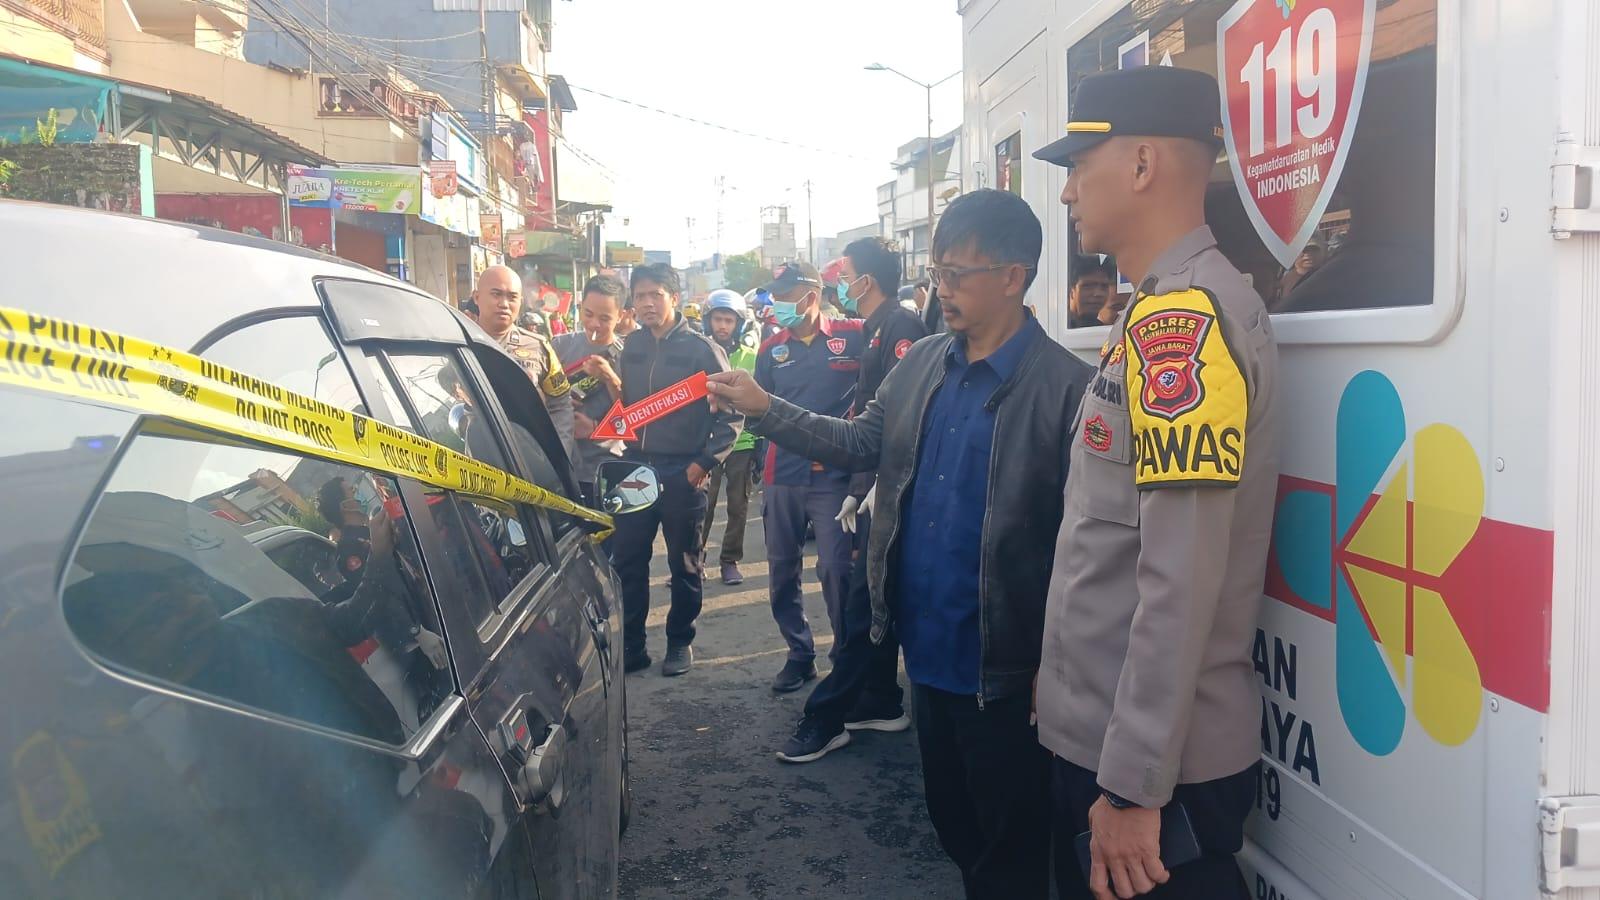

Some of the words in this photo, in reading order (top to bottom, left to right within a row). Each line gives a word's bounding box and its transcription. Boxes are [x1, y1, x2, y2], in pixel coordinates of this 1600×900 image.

[1240, 7, 1337, 158] 119
[1247, 147, 1310, 180] Kegawatdaruratan
[1311, 138, 1335, 158] Medik
[1257, 164, 1320, 199] INDONESIA
[1138, 317, 1197, 337] POLRES
[1148, 344, 1166, 355] JAWA
[1167, 342, 1192, 352] BARAT
[626, 387, 689, 425] IDENTIFIKASI
[235, 397, 257, 422] DO
[263, 405, 289, 432] NOT
[293, 415, 338, 454] CROSS
[380, 441, 415, 474] POLICE
[411, 452, 433, 478] LINE
